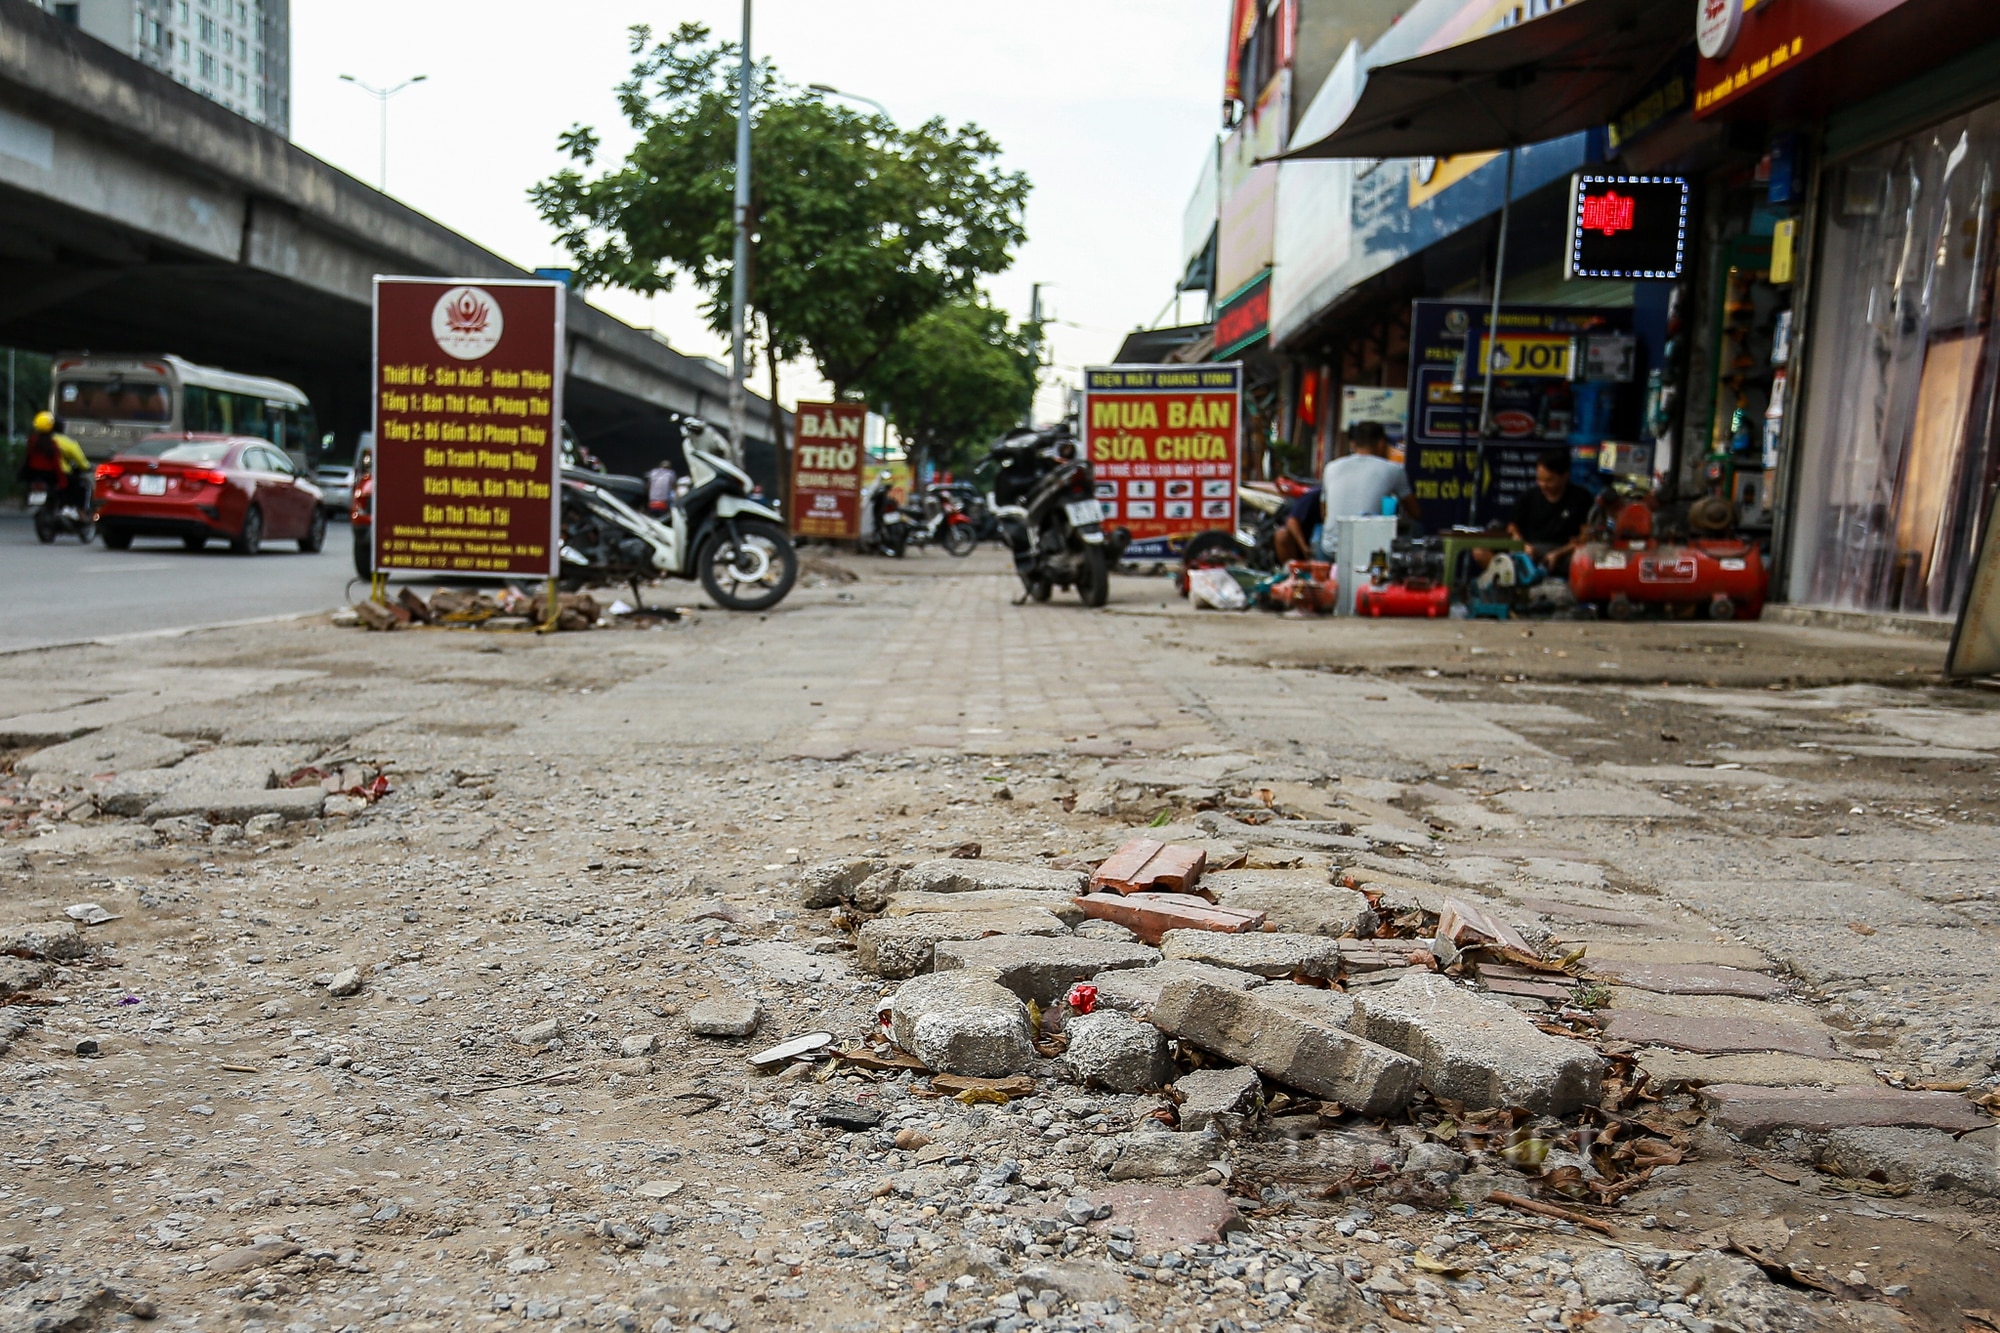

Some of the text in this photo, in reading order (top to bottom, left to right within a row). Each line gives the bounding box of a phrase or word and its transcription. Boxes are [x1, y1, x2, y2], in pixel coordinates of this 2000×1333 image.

[801, 409, 860, 438] BÀN
[1093, 401, 1158, 429] MUA
[798, 441, 857, 471] THỜ
[1094, 430, 1227, 461] SỬA CHỮA
